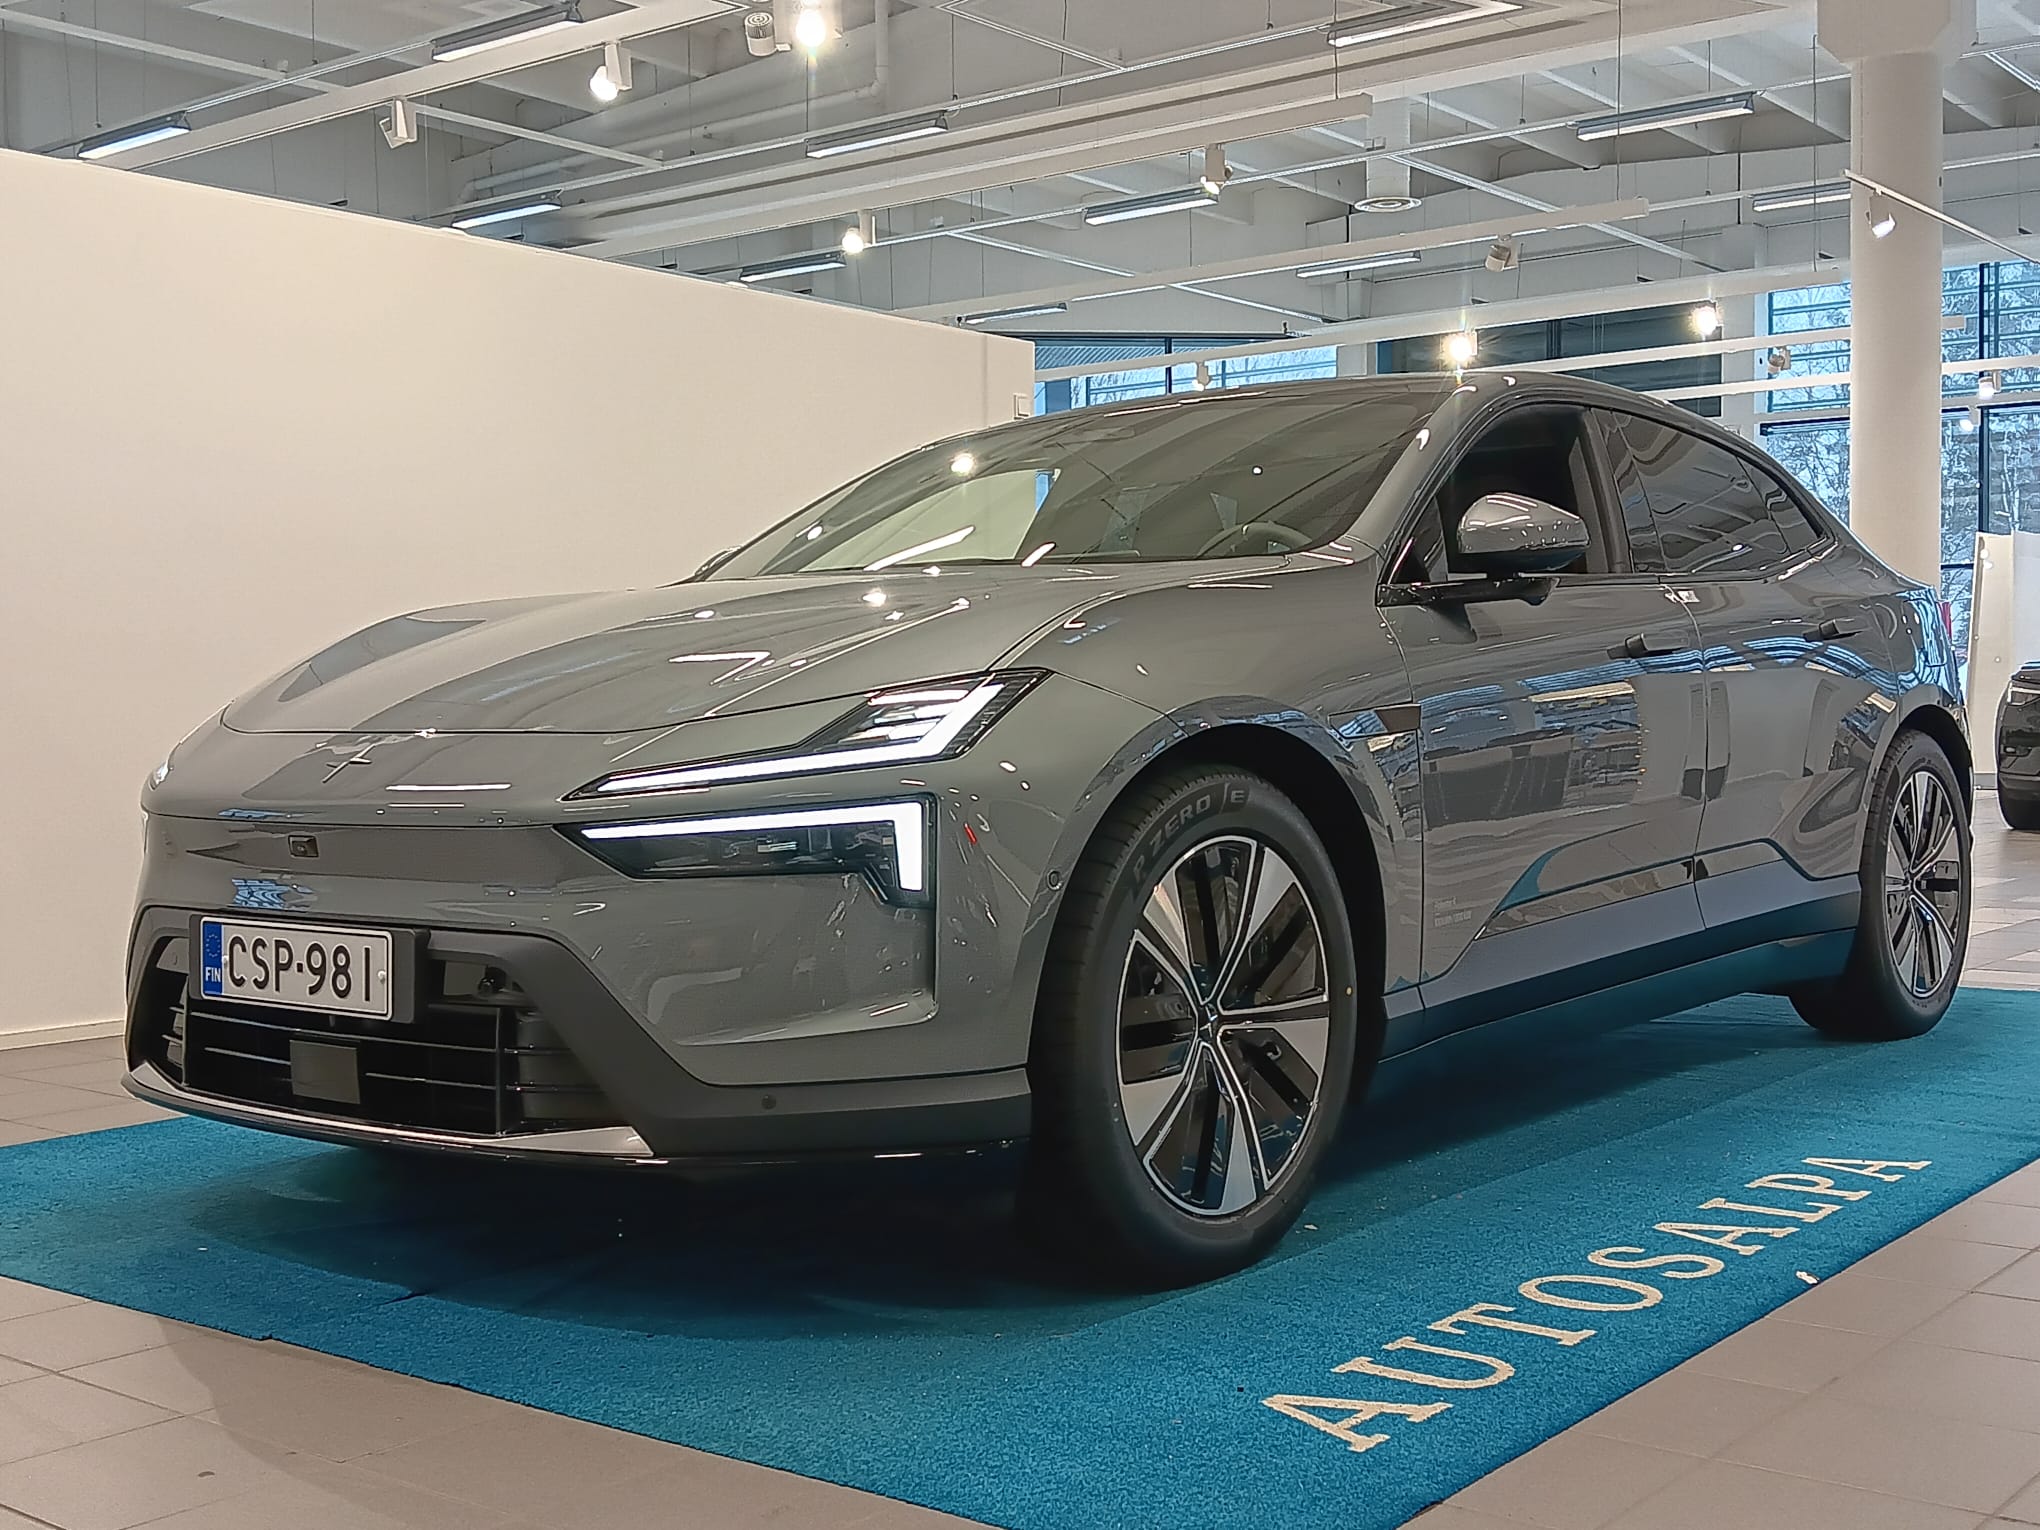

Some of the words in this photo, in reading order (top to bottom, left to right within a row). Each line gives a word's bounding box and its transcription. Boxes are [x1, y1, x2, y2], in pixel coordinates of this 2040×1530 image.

[1150, 794, 1212, 857] ZERO
[1230, 789, 1246, 804] E
[205, 966, 222, 984] FIN
[1261, 1155, 1932, 1454] AUTOSALPA
